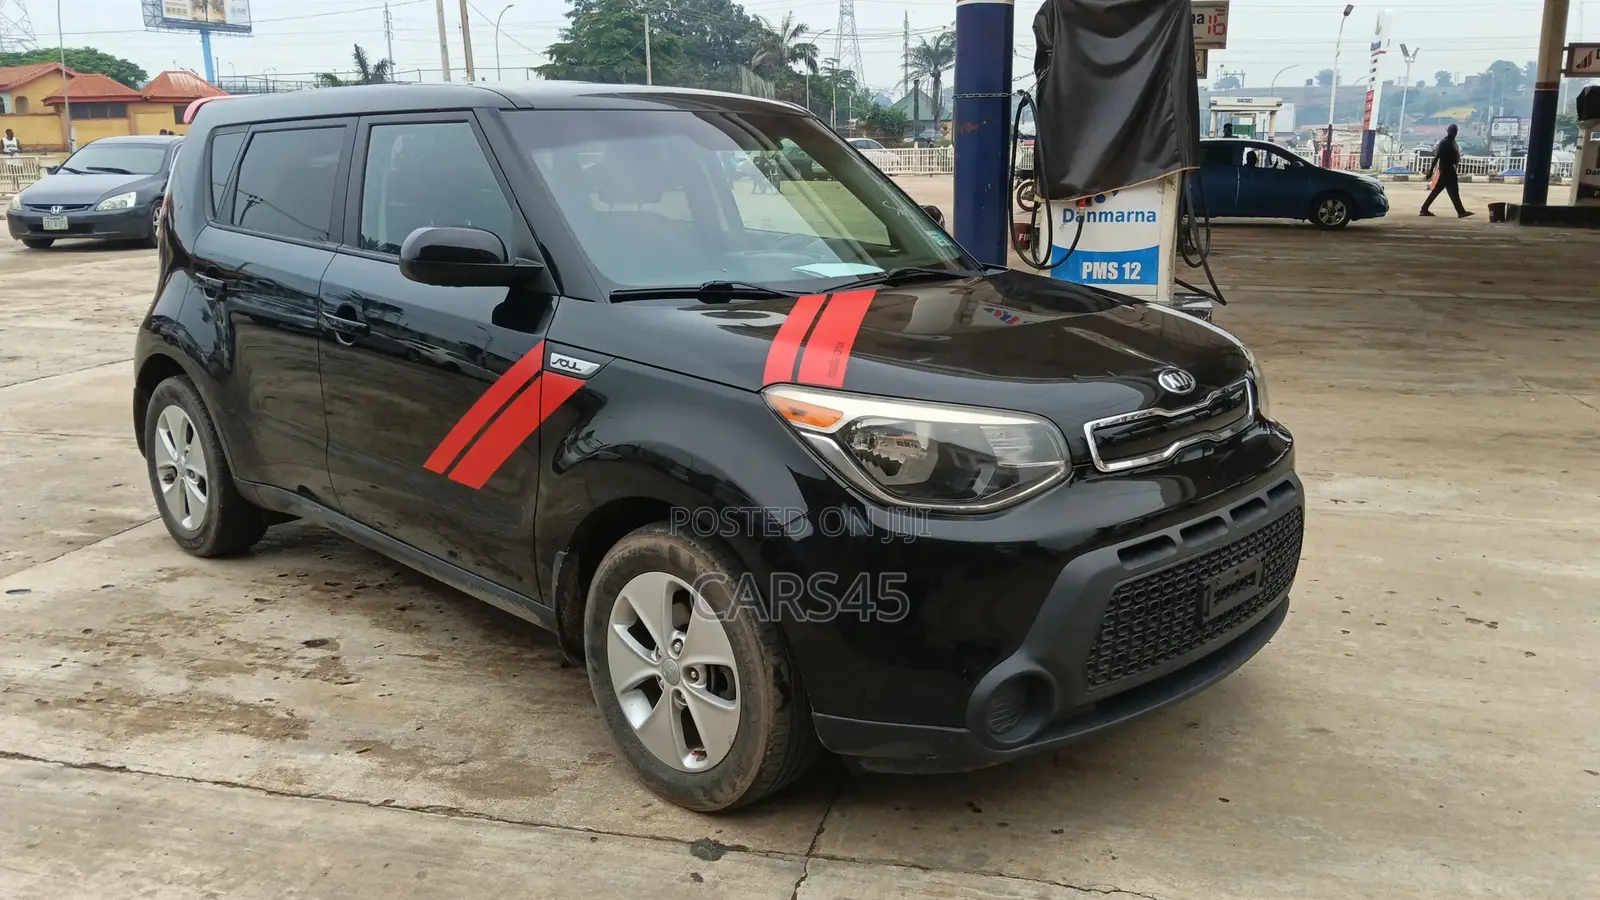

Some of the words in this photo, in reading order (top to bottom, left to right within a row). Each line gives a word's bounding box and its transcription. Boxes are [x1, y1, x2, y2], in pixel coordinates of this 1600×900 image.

[1062, 208, 1157, 223] Danmarna
[1081, 262, 1119, 280] PMS
[1122, 262, 1142, 280] 12
